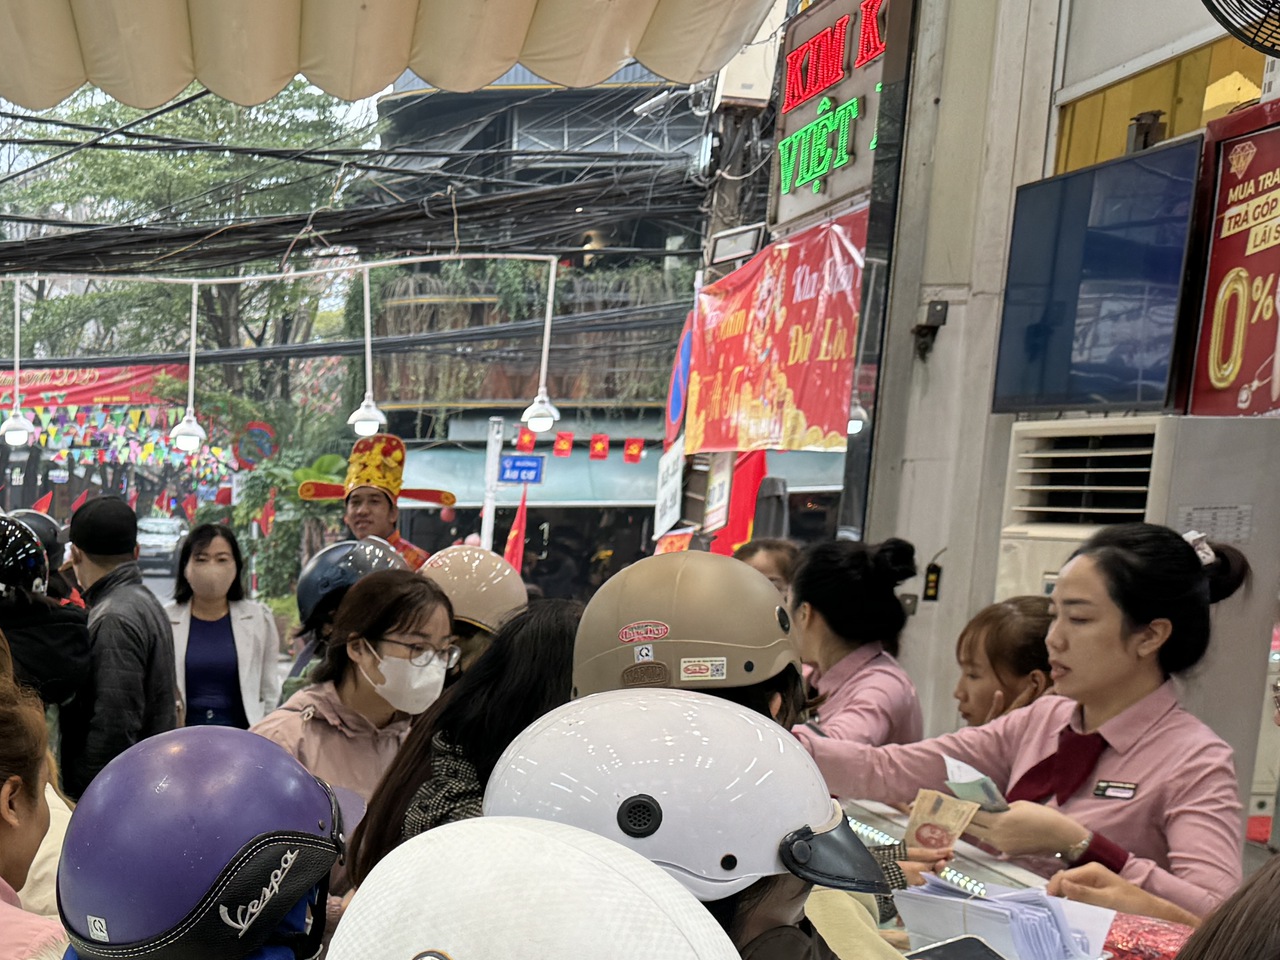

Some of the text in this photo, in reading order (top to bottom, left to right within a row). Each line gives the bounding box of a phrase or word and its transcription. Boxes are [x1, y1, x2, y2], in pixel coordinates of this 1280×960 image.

[782, 14, 850, 114] KIM
[778, 97, 859, 195] VIỆT
[1227, 179, 1256, 205] MUA
[1227, 195, 1278, 232] TRẢ GÓP
[1253, 225, 1272, 249] LÃI
[53, 367, 99, 387] 2025
[219, 849, 300, 939] Vespa
